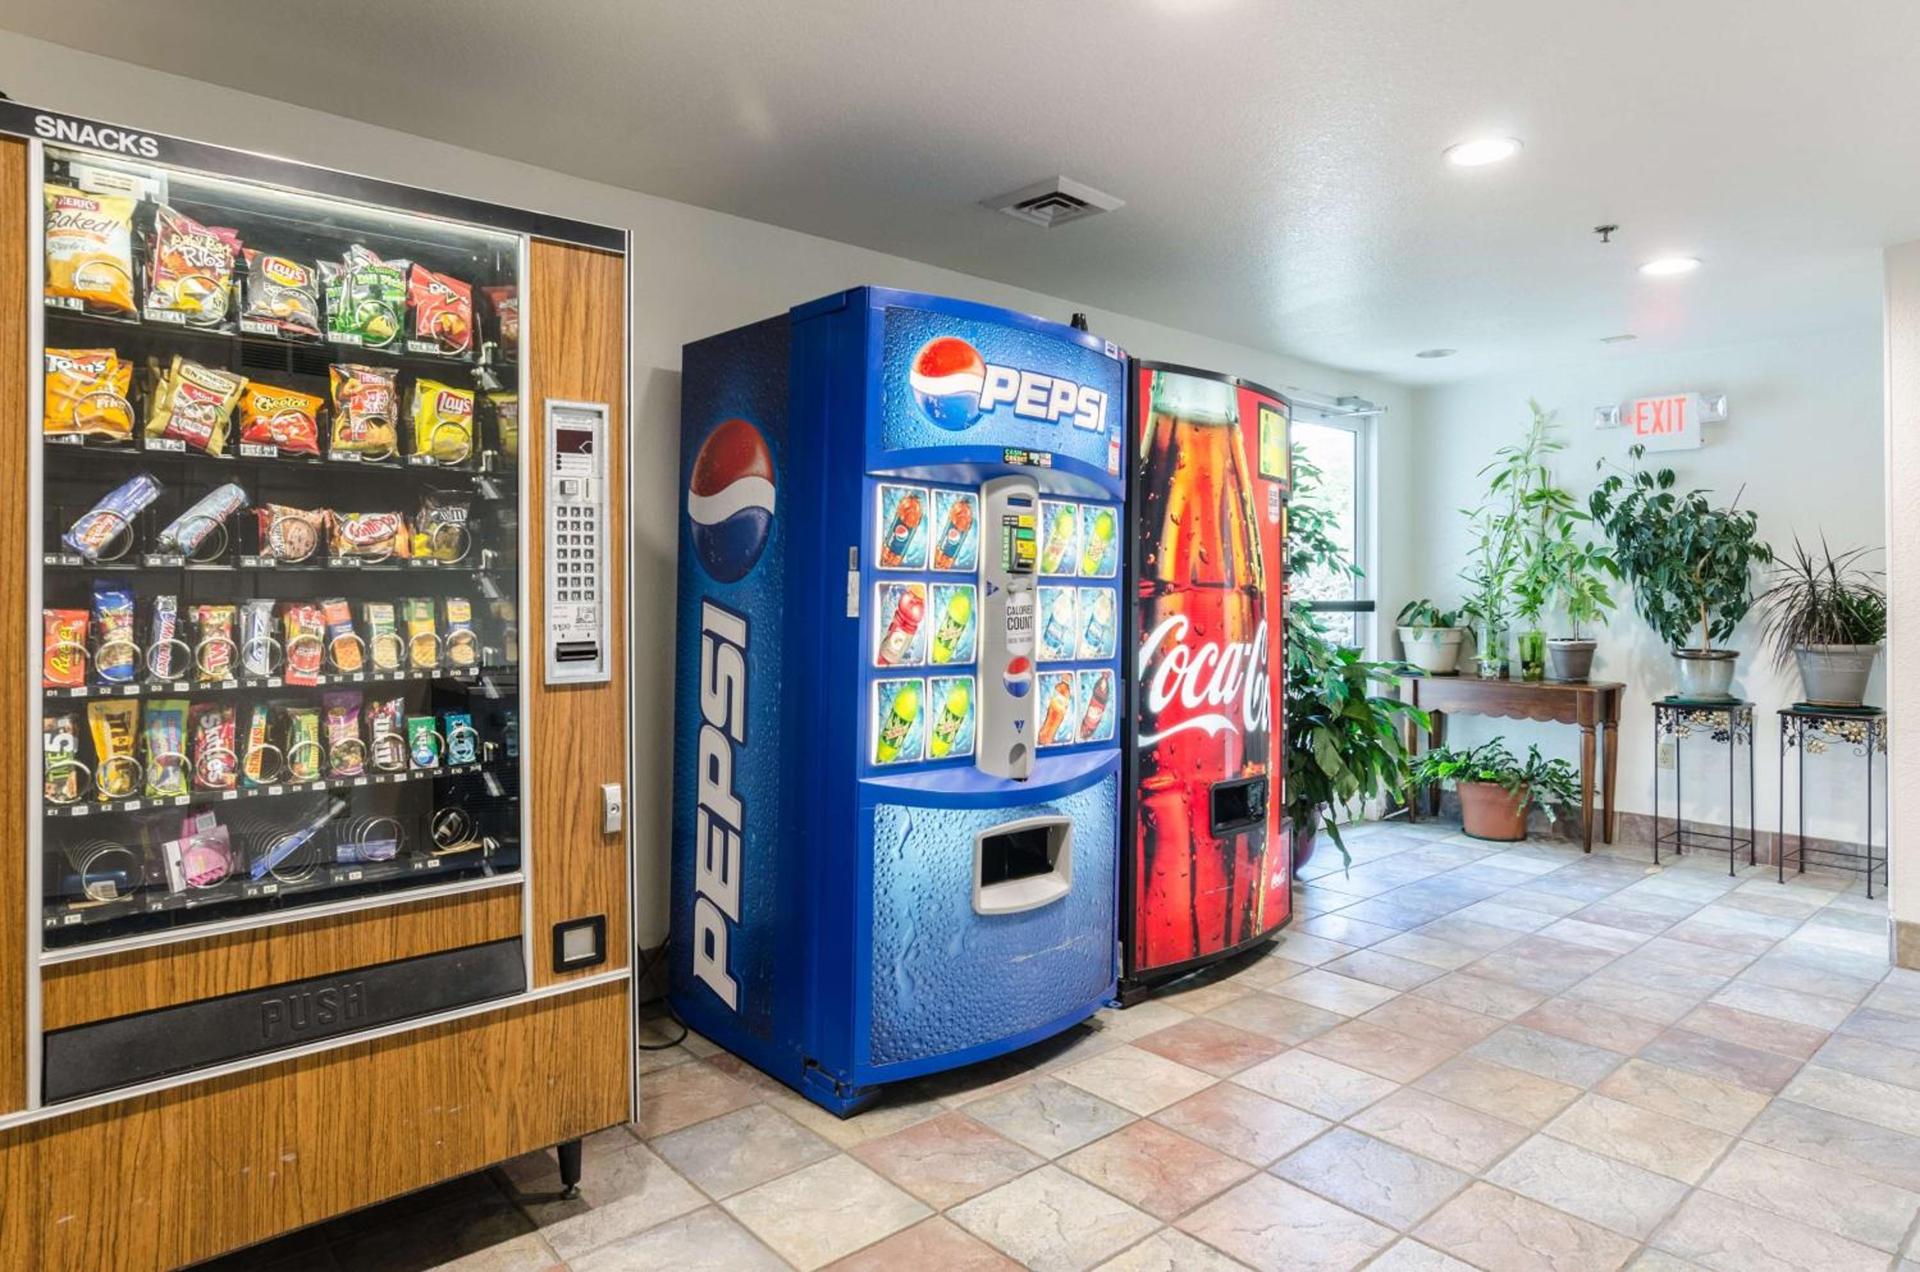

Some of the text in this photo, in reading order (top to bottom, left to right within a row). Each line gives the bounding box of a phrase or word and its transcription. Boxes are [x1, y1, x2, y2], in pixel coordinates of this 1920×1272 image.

[34, 115, 159, 158] SNACKS
[438, 391, 471, 415] Lay's
[978, 364, 1109, 433] PEPSI
[1636, 398, 1686, 435] EXIT
[44, 733, 75, 753] 5
[693, 600, 747, 1012] PEPSI
[261, 981, 367, 1040] PUSH
